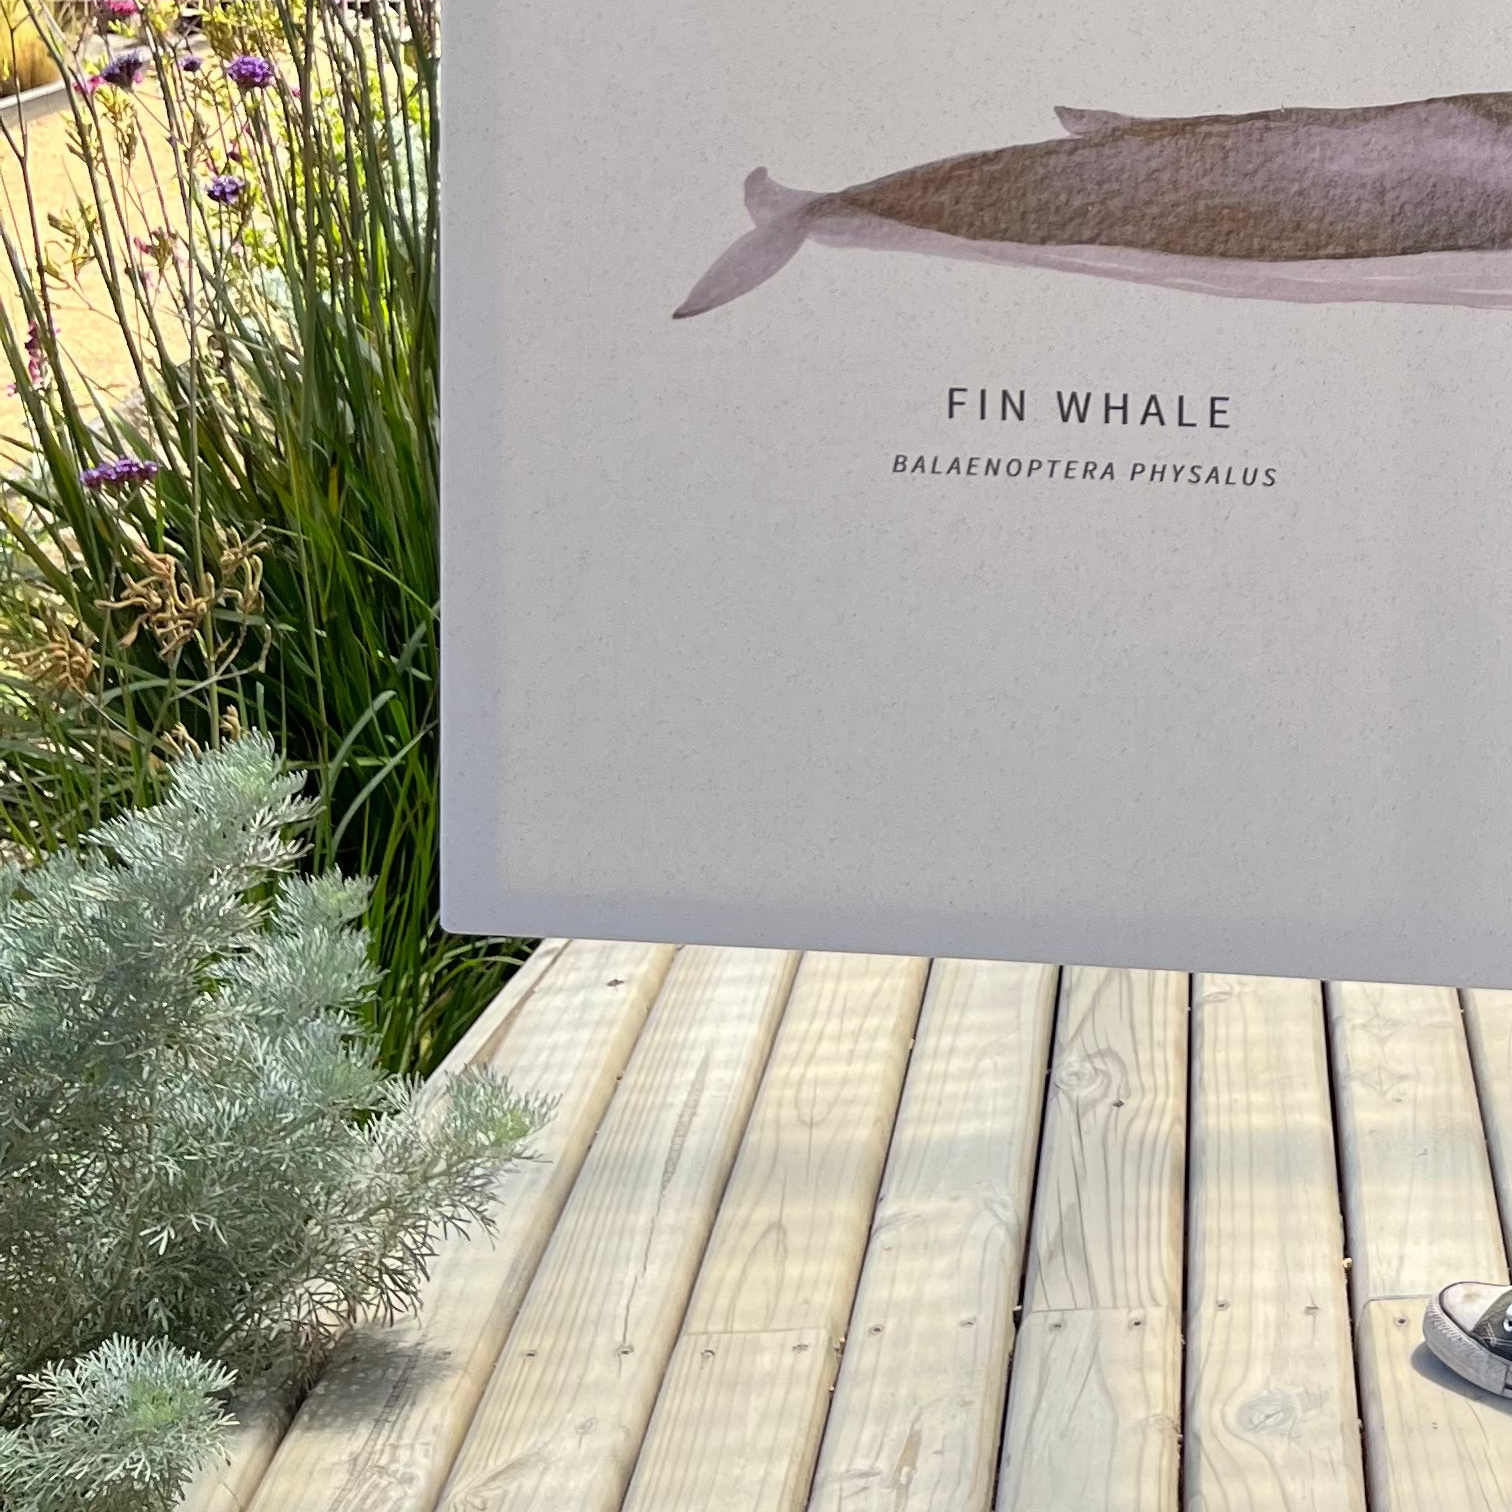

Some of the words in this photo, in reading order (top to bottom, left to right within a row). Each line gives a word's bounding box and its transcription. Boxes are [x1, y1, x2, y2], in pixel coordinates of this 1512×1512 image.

[947, 387, 1025, 422] FIN
[1055, 389, 1231, 429] WHALE
[891, 453, 1116, 481] BALAENOPTERA
[1128, 461, 1278, 487] PHYSALUS
